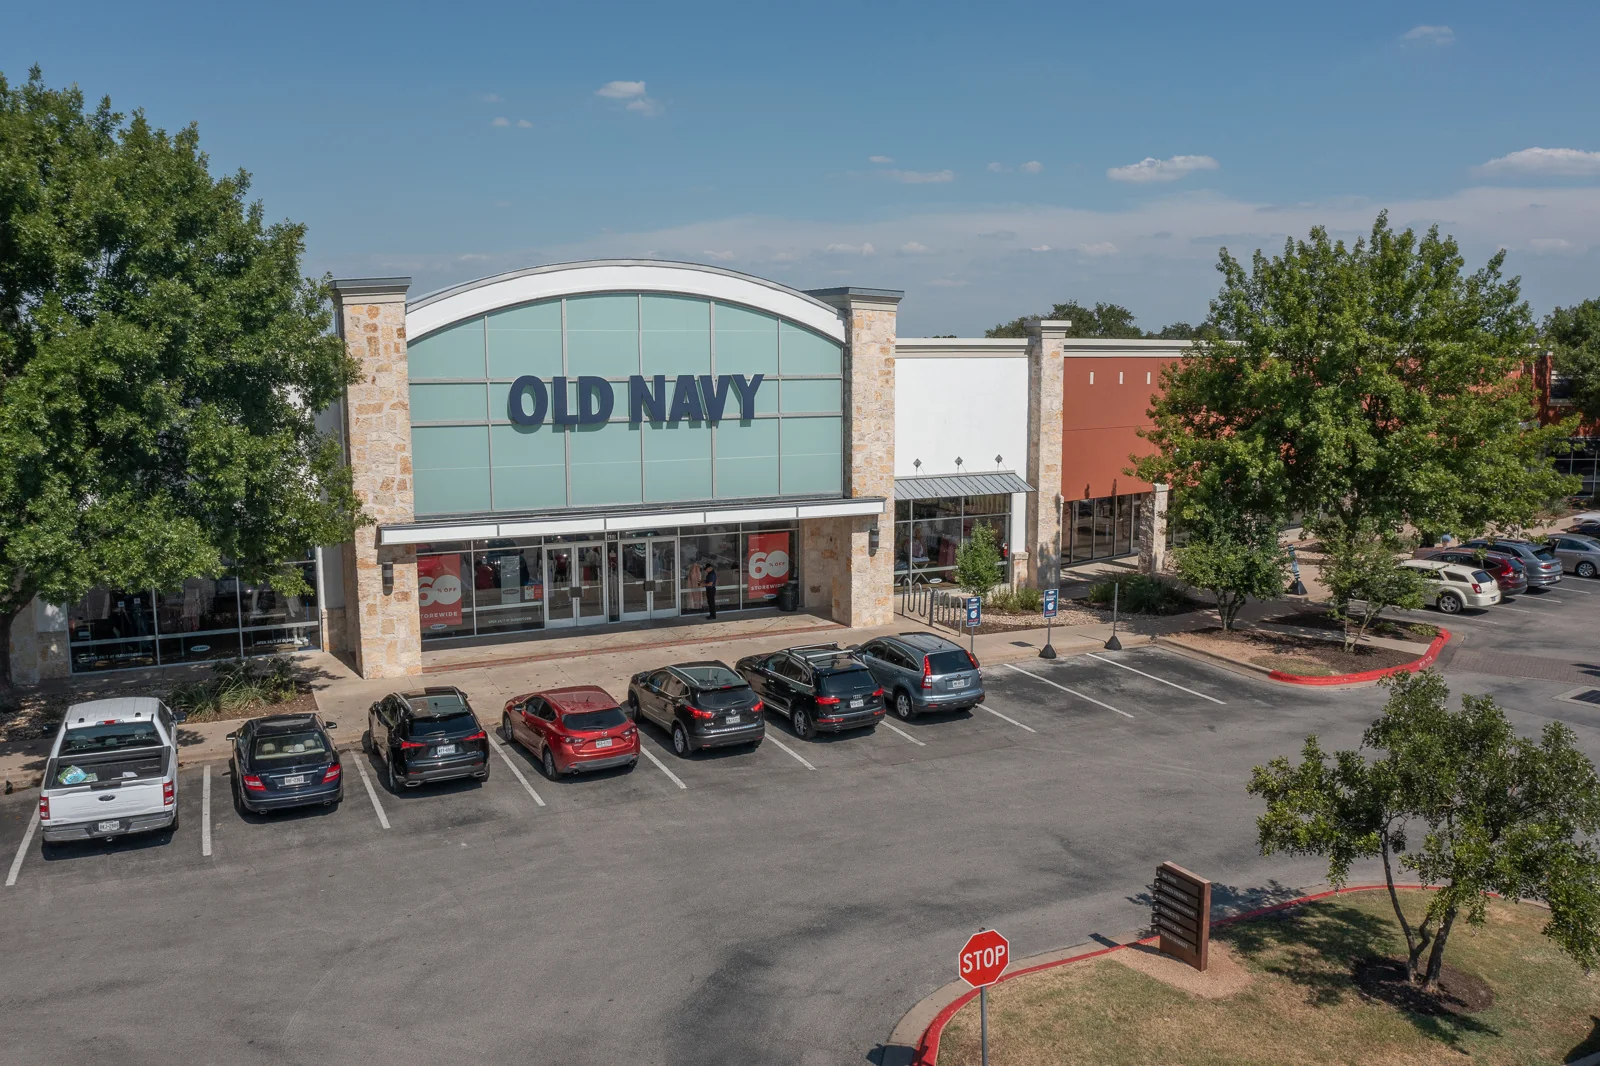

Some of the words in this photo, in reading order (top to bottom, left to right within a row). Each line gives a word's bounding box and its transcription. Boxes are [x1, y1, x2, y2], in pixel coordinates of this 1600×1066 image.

[508, 375, 614, 426] OLD
[628, 374, 764, 423] NAVY
[749, 550, 789, 579] 60
[418, 574, 461, 607] 60
[420, 611, 458, 619] TOREWIDE
[962, 944, 1006, 974] STOP
